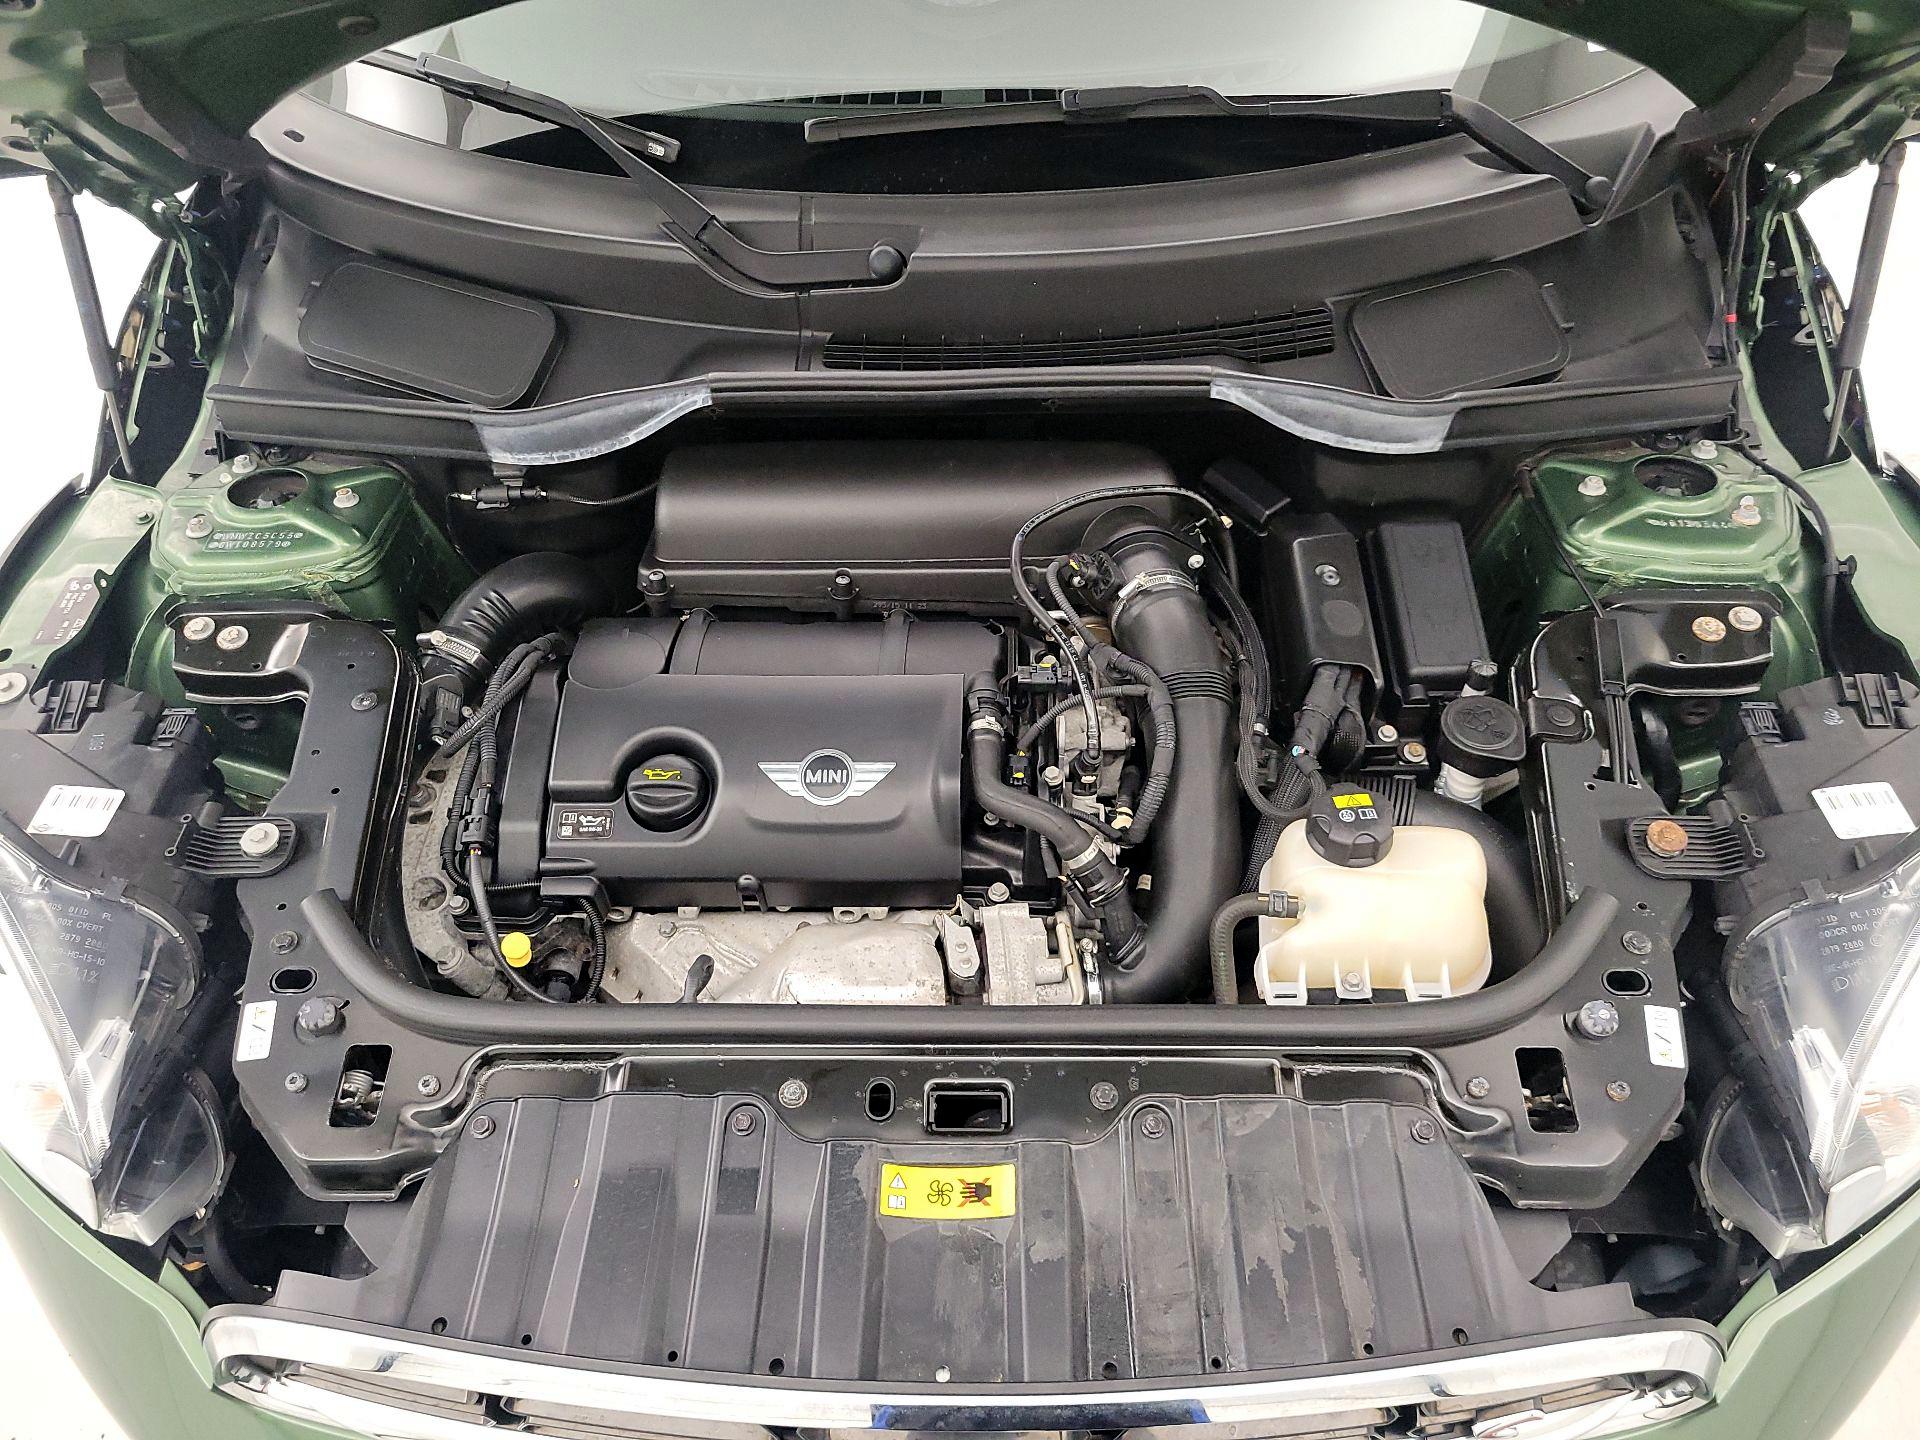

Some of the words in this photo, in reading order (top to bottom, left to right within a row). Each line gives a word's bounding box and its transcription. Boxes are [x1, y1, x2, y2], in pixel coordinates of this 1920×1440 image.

[805, 769, 847, 783] MINI
[1849, 911, 1861, 919] PL
[76, 920, 104, 932] CVERT
[1842, 939, 1864, 950] 2880
